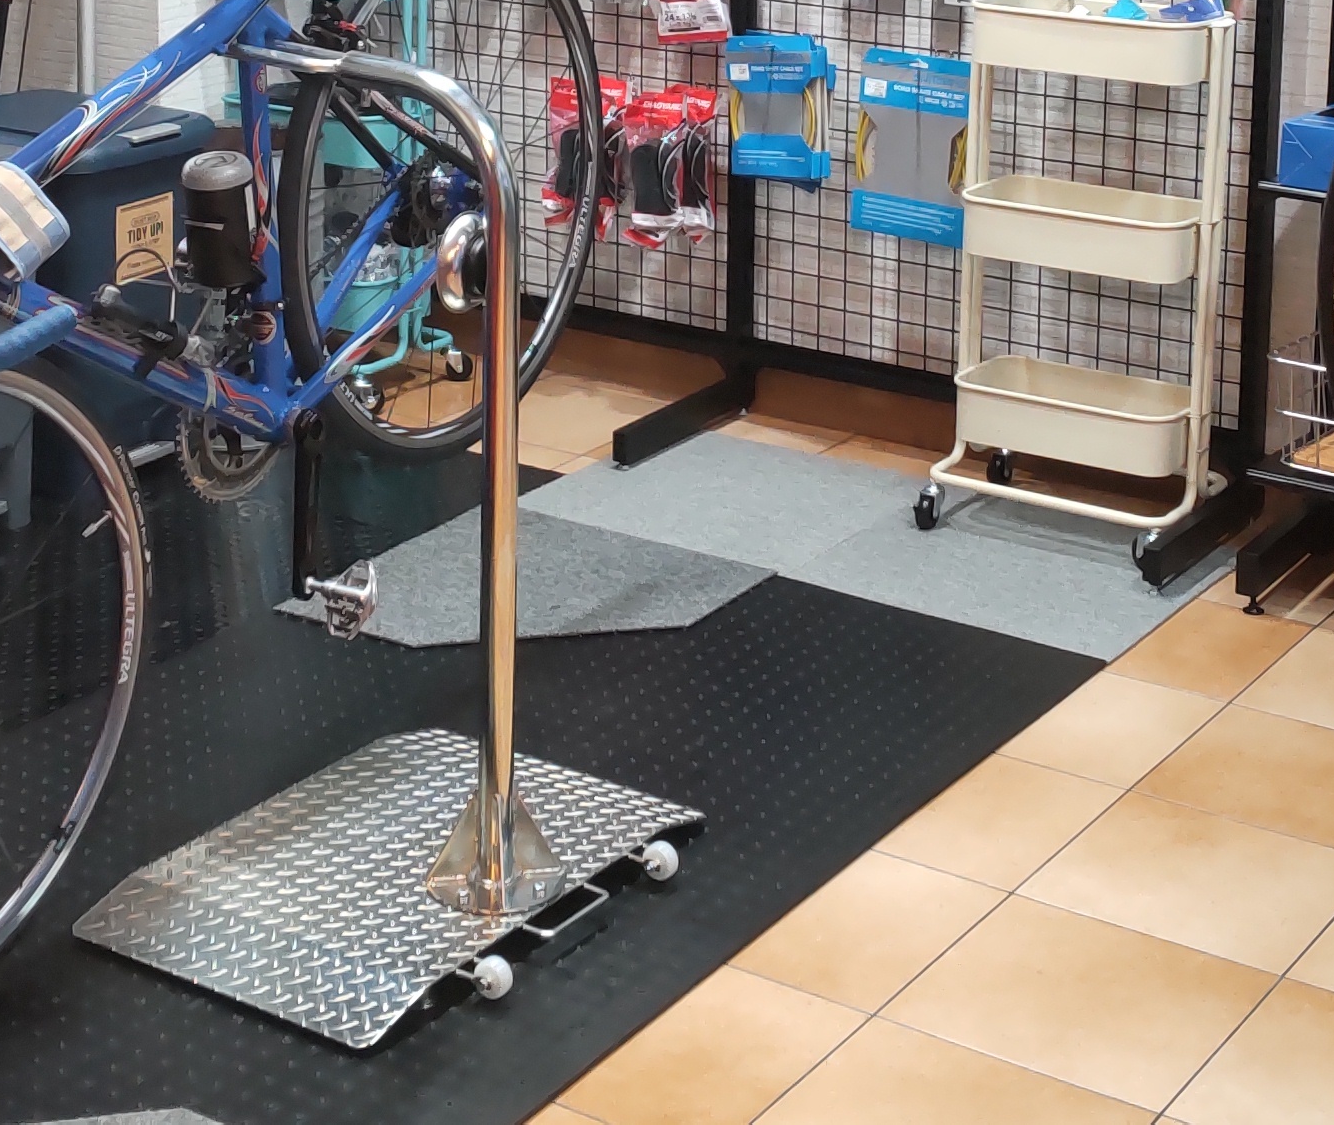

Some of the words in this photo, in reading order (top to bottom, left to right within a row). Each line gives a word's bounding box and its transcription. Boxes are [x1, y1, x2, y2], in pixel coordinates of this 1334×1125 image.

[127, 226, 148, 244] TIDY
[568, 195, 591, 269] ULTEGRA
[117, 591, 137, 686] ULTEGRA
